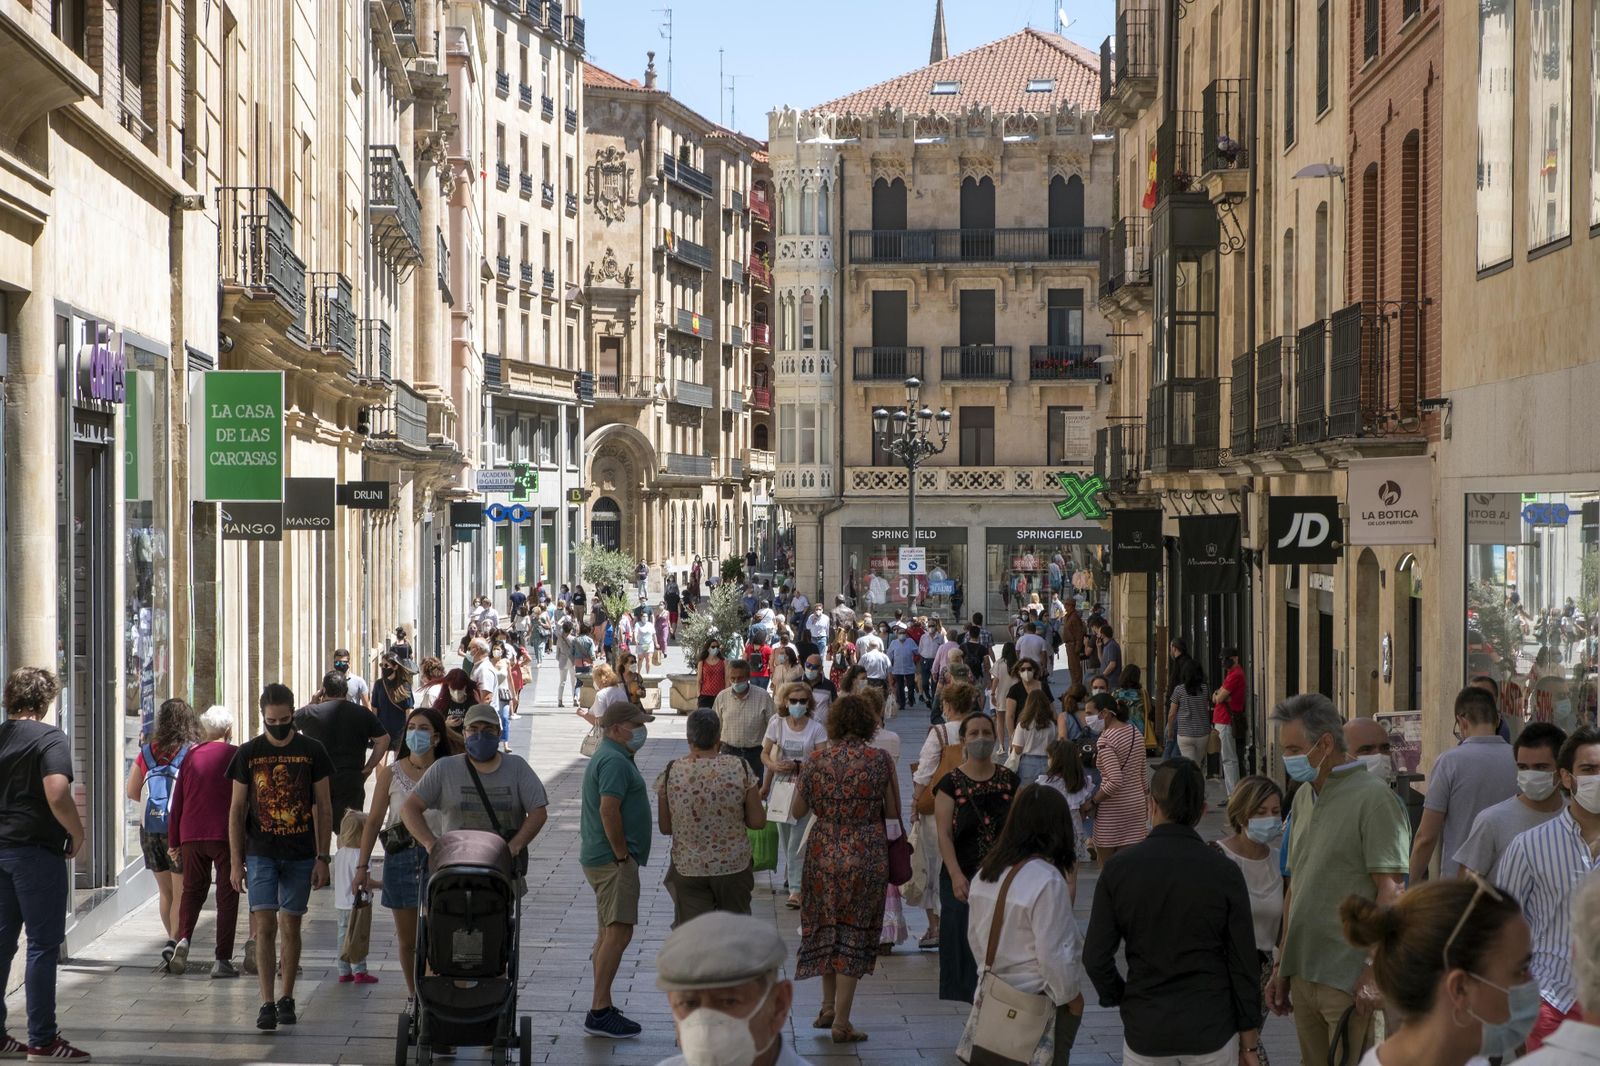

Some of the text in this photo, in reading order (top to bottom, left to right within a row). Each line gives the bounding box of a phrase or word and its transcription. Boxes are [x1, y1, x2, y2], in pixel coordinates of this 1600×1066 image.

[211, 404, 275, 418] LA CASA
[216, 427, 270, 442] DE LAS
[209, 451, 277, 466] CARCASAS
[354, 490, 383, 500] DRUNI
[572, 489, 581, 501] B
[1361, 509, 1419, 520] LA BOTICA
[286, 517, 330, 526] MANGO
[871, 530, 937, 539] SPRINGIELD
[1016, 530, 1083, 539] SPRINGFIELD
[1277, 512, 1330, 549] JD
